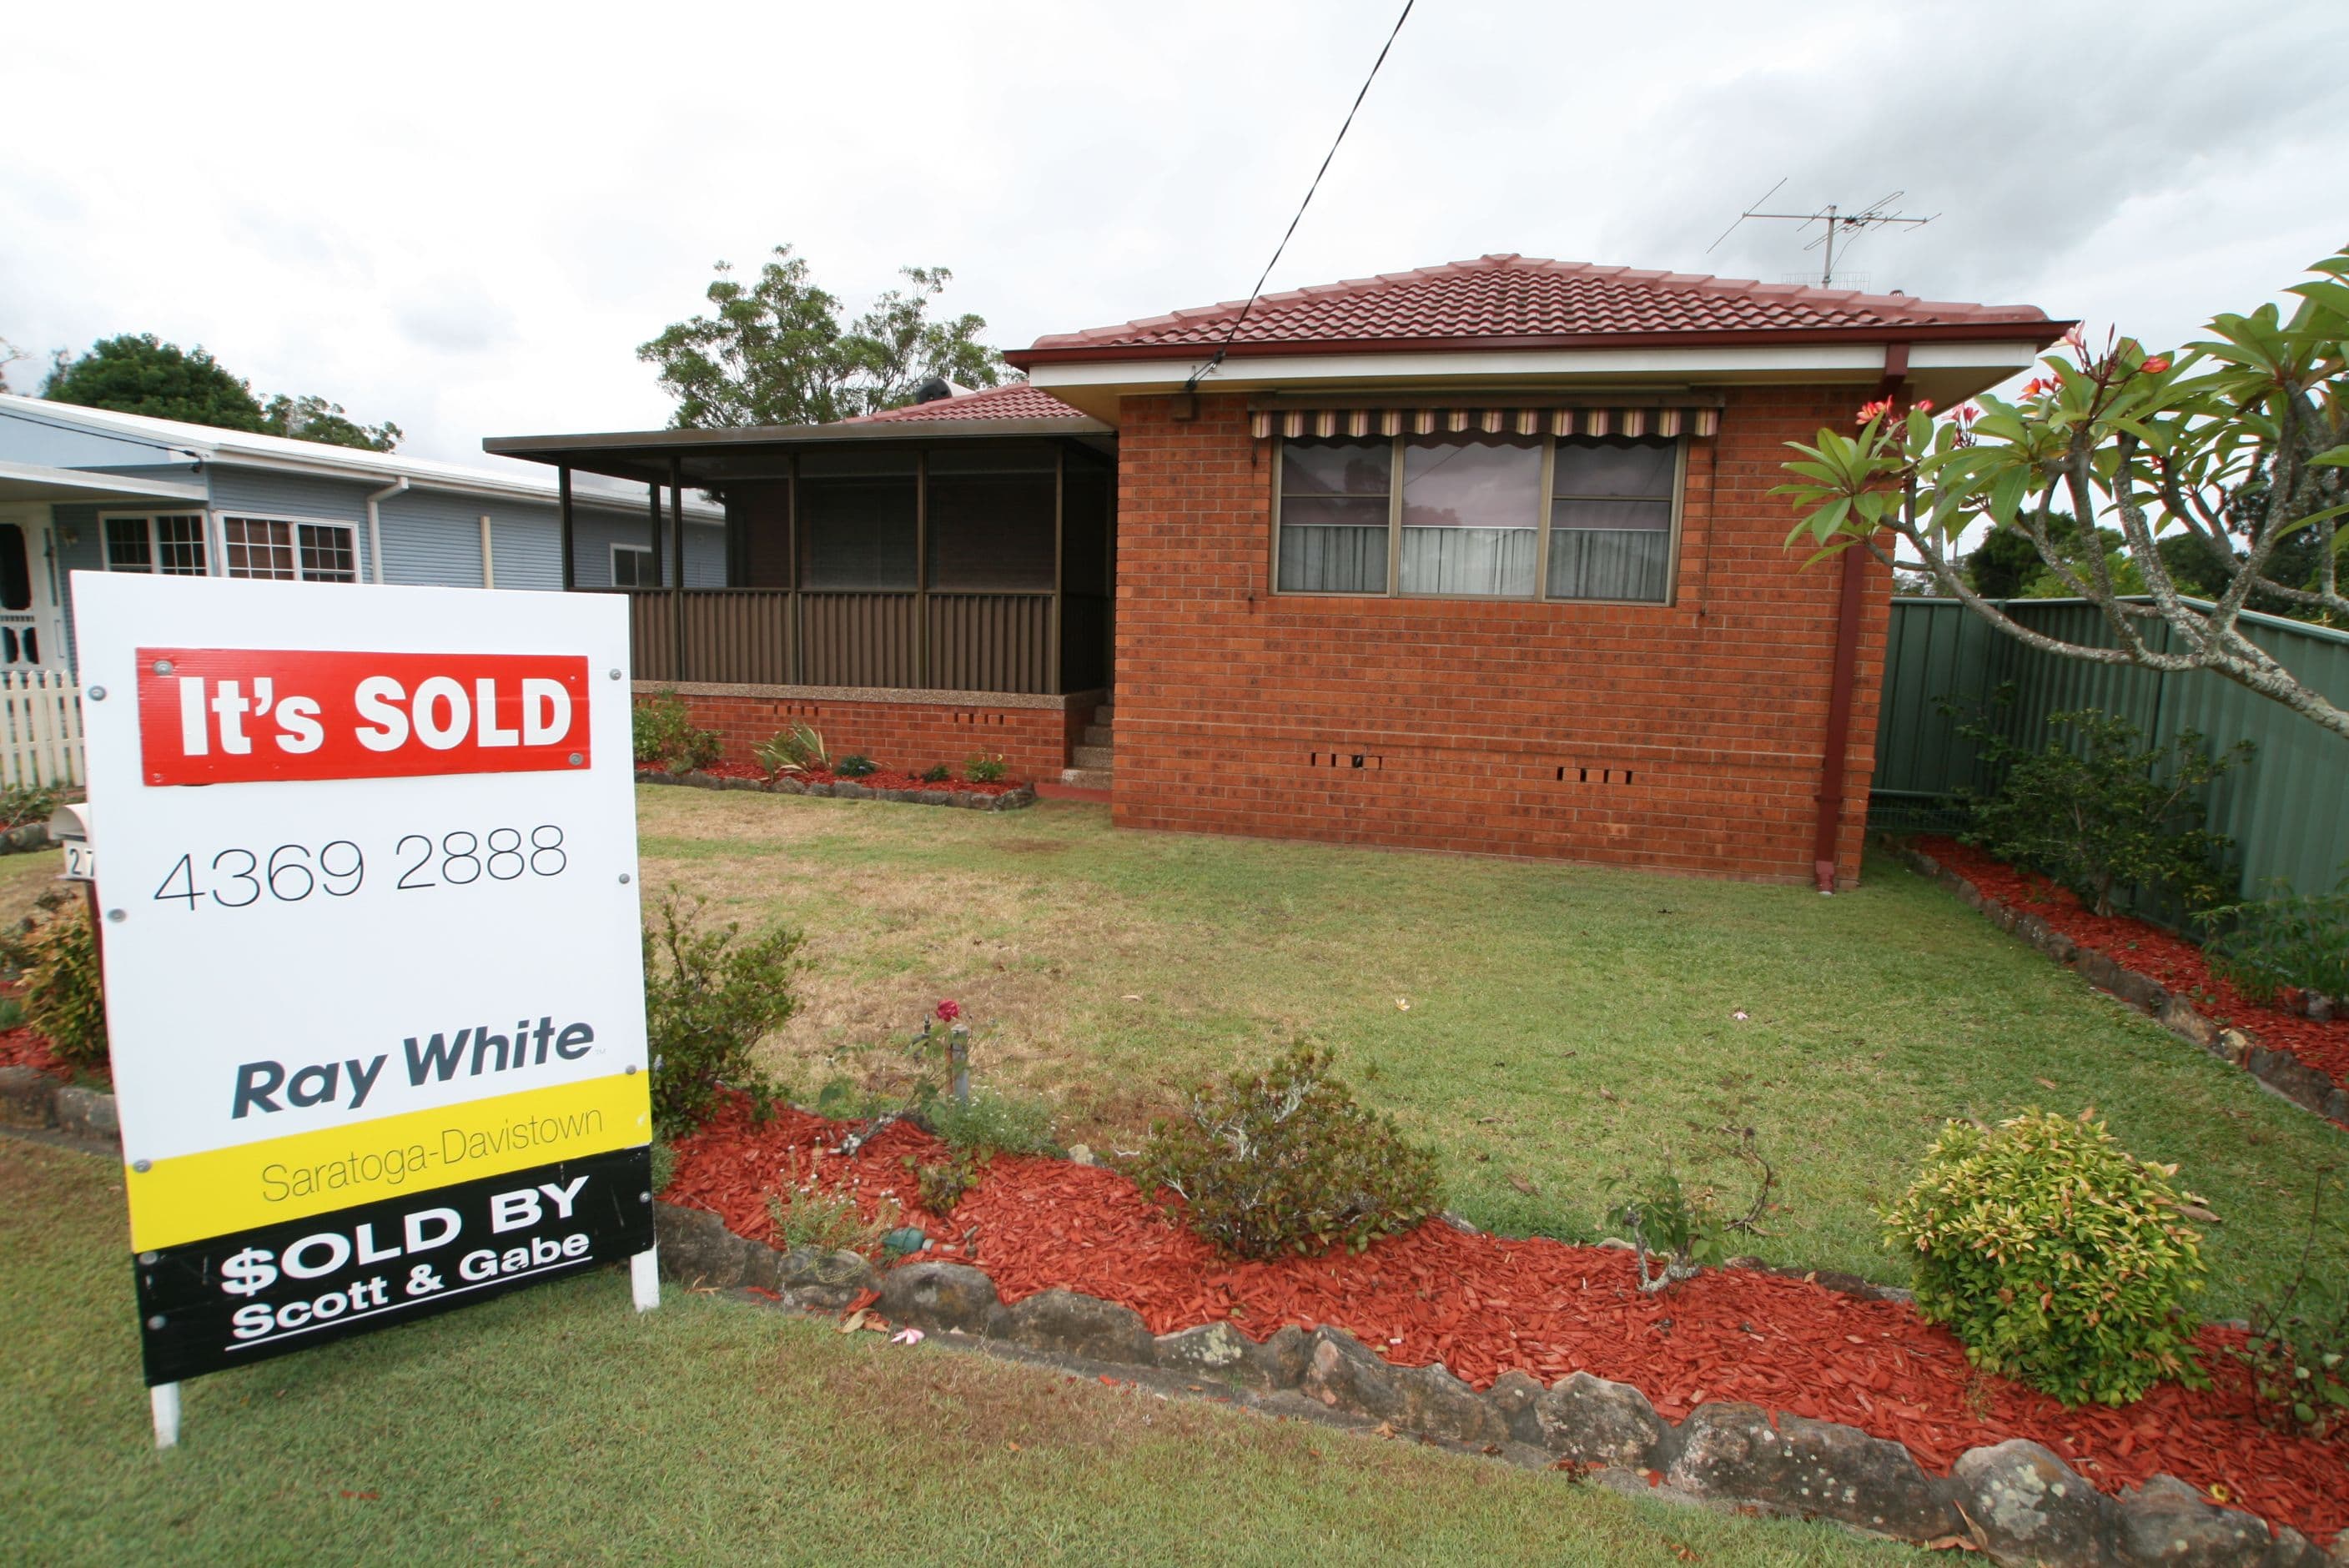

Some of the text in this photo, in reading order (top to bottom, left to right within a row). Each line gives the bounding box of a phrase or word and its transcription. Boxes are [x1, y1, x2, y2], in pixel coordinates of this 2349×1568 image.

[179, 676, 572, 756] It's SOLD
[153, 824, 568, 912] 4369 2888
[232, 1016, 595, 1119] Ray White
[260, 1107, 603, 1203] Saratoga-Davistown
[220, 1175, 590, 1298] $OLD BY
[232, 1233, 590, 1339] Scott & Gabe
